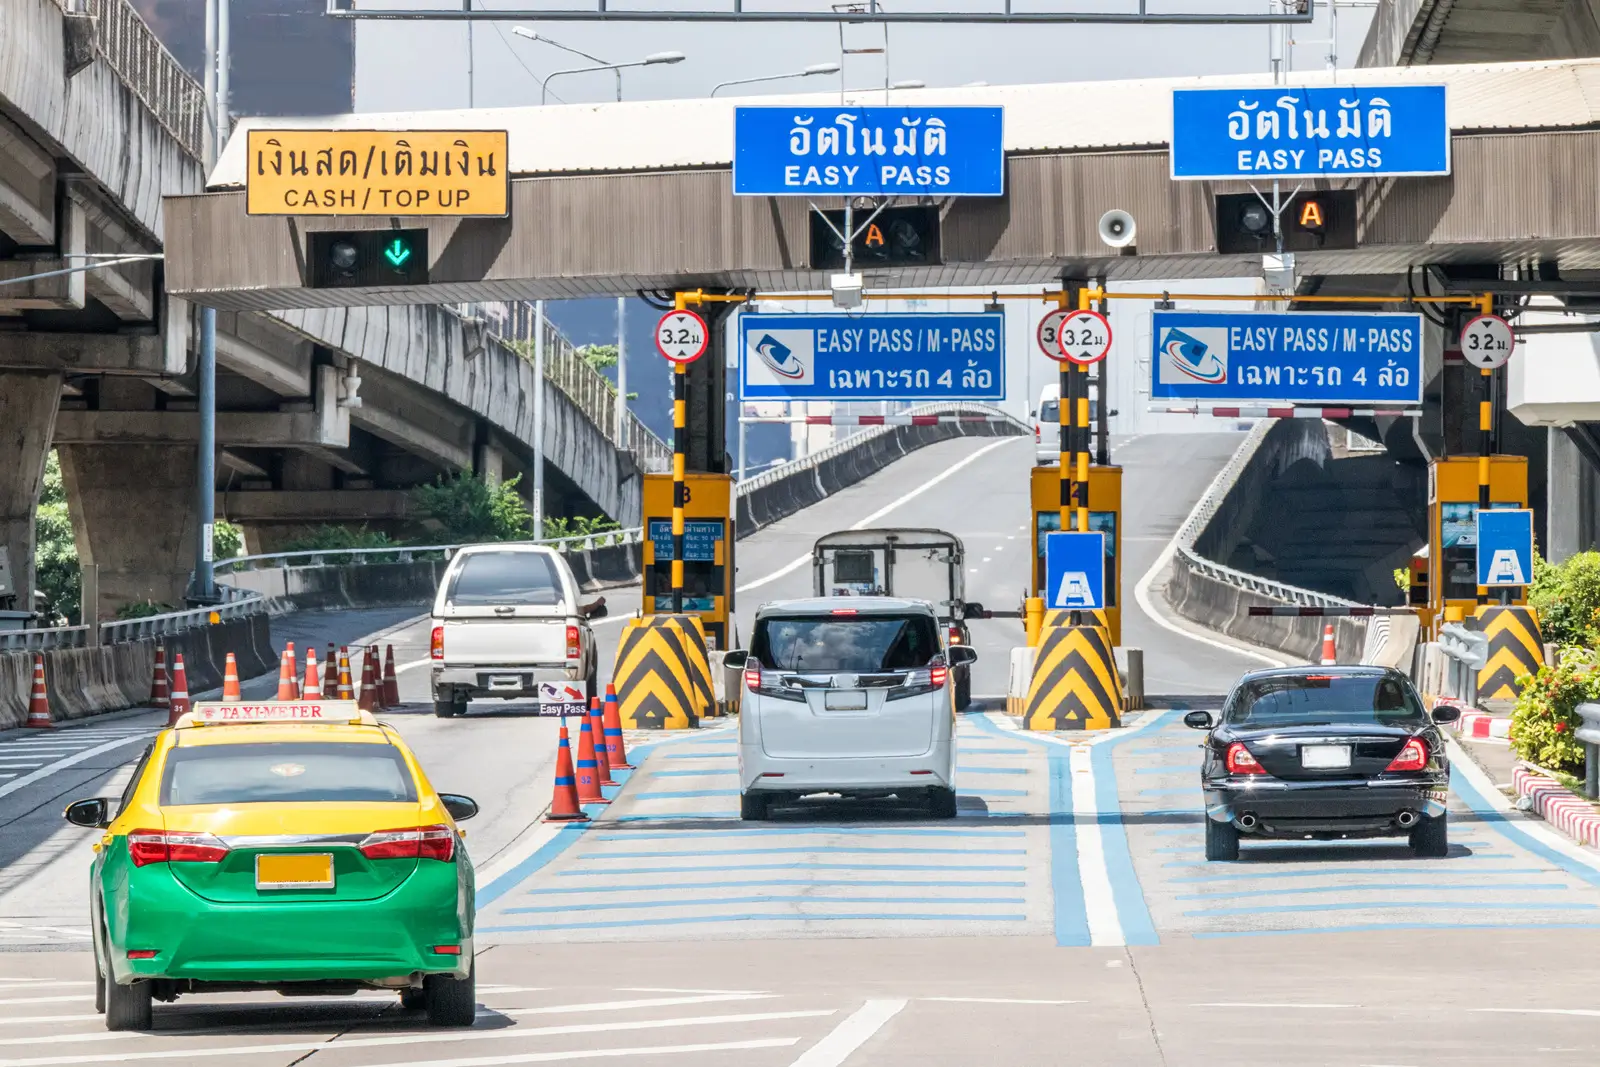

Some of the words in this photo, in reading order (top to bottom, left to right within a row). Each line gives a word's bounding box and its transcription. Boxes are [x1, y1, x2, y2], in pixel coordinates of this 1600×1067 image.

[1227, 95, 1392, 140] อัตโนมัติ
[789, 113, 947, 156] อัตโนมัติ
[1237, 149, 1305, 171] EASY
[1318, 147, 1383, 169] PASS
[784, 165, 860, 186] EASY
[881, 165, 951, 186] PASS
[438, 189, 471, 207] UP
[1300, 201, 1323, 226] A
[865, 223, 884, 245] A
[817, 328, 863, 353] EASY
[869, 328, 913, 352] PASS
[1230, 327, 1278, 351] EASY
[1283, 327, 1328, 352] PASS
[829, 369, 929, 389] เฉพาะรถ
[936, 369, 953, 388] 4
[962, 359, 992, 389] ล้อ
[1237, 364, 1341, 386] เฉพาะรถ
[1352, 366, 1367, 386] 4
[1378, 359, 1409, 387] ล้อ
[220, 705, 323, 720] TAXI-METER
[540, 703, 562, 717] Easy
[564, 703, 586, 714] Pass
